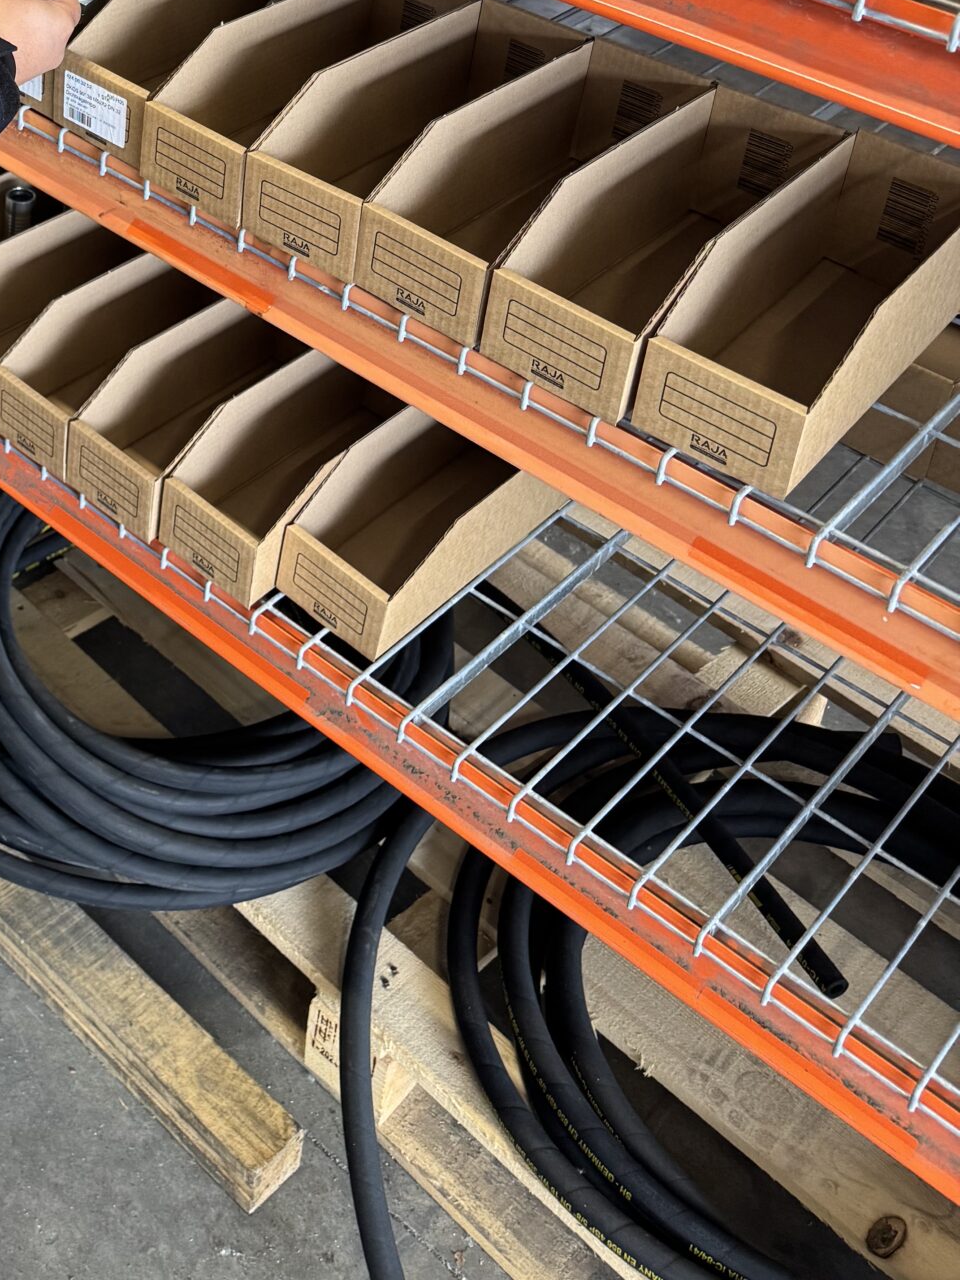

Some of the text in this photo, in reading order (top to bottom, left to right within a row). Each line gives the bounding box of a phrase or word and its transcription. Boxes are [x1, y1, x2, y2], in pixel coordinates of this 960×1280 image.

[176, 177, 200, 197] RAJA
[283, 232, 310, 253] RAJA
[396, 287, 425, 311] RAJA
[531, 358, 565, 385] RAJA
[17, 433, 36, 452] RAJA
[691, 434, 728, 459] RAJA
[97, 490, 118, 509] RAJA
[193, 553, 215, 573] RAJA
[314, 602, 338, 625] RAJA
[567, 1124, 578, 1141] EN
[578, 1138, 615, 1183] GERMANY
[619, 1185, 632, 1201] SH
[559, 1196, 573, 1213] DN
[589, 1226, 607, 1243] 4SP
[606, 1239, 622, 1255] 856
[623, 1251, 637, 1267] EN
